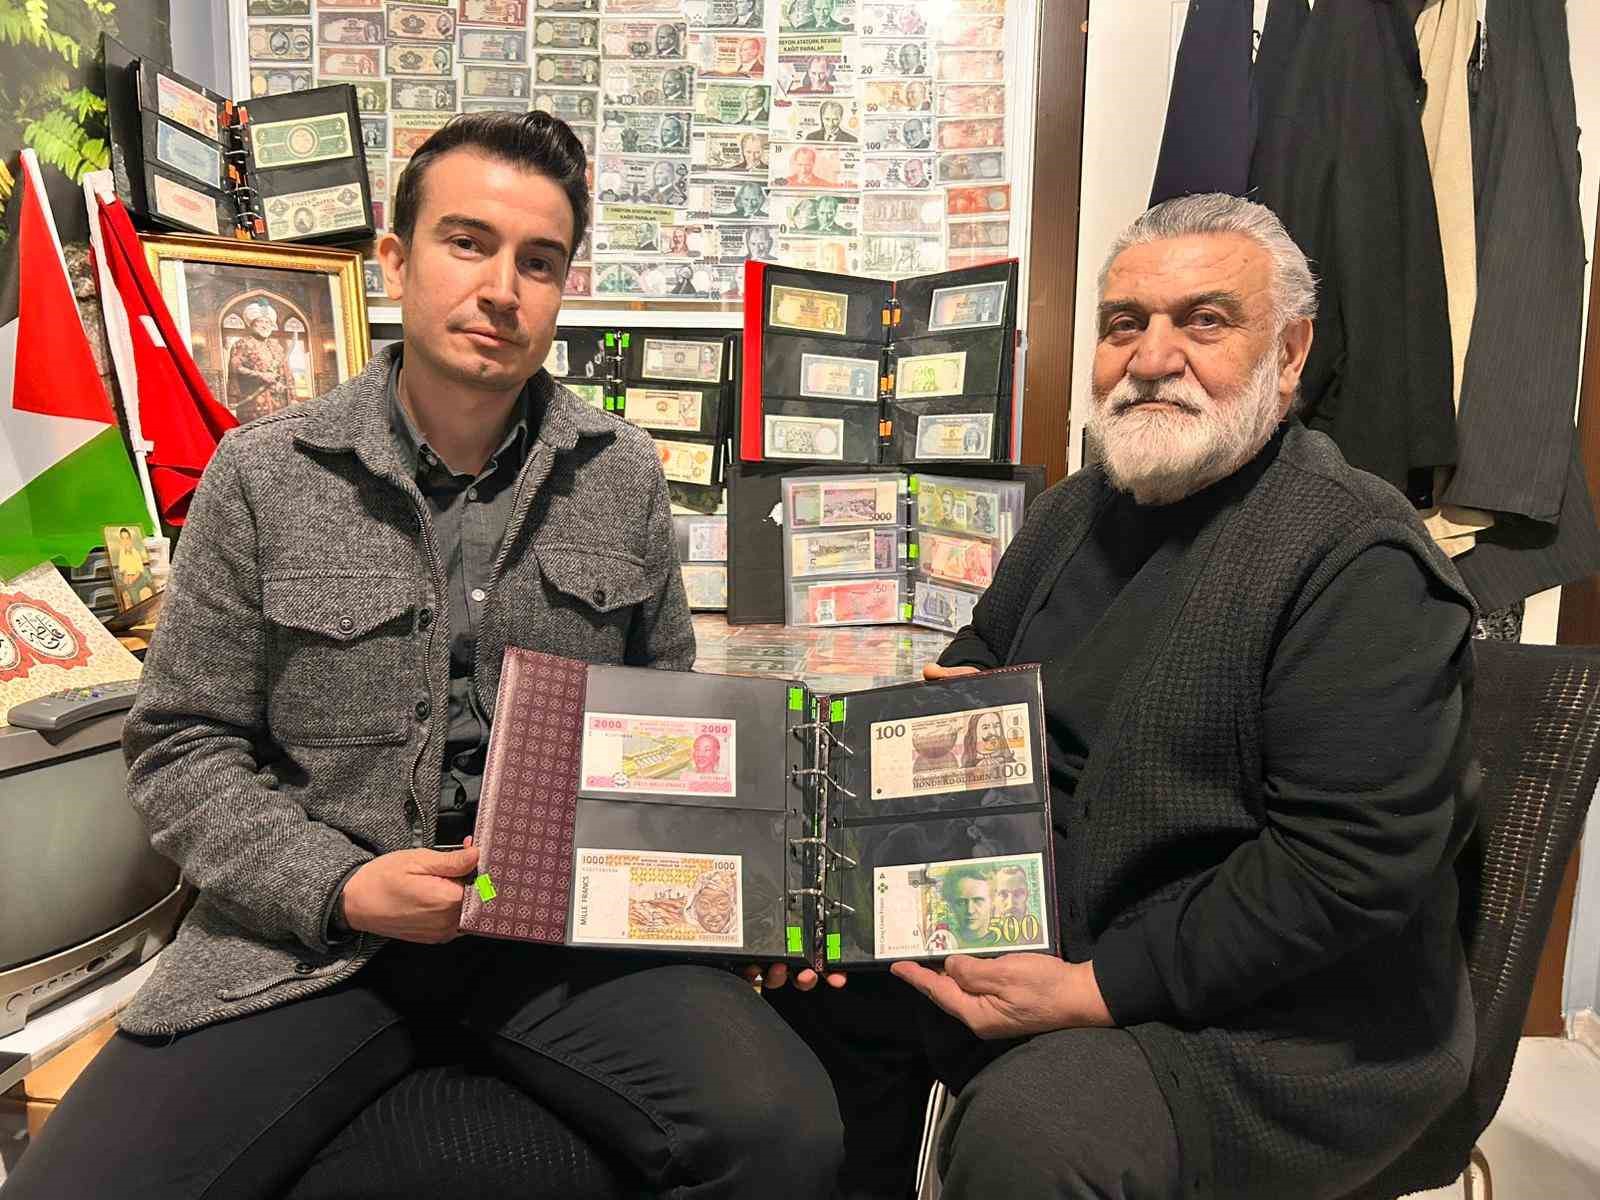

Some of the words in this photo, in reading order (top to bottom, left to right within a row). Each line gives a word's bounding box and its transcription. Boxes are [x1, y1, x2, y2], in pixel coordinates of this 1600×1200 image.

[861, 65, 873, 74] 20
[867, 103, 878, 112] 50
[866, 141, 881, 150] 100
[865, 179, 881, 188] 200
[869, 512, 892, 522] 5000
[594, 719, 623, 729] 2000
[701, 724, 728, 734] 2000
[874, 724, 906, 741] 100
[994, 762, 1027, 780] 100
[583, 855, 604, 865] 1000
[714, 861, 735, 871] 1000
[582, 876, 590, 903] FRANCS
[580, 905, 588, 926] MILLE
[987, 914, 1040, 944] 500
